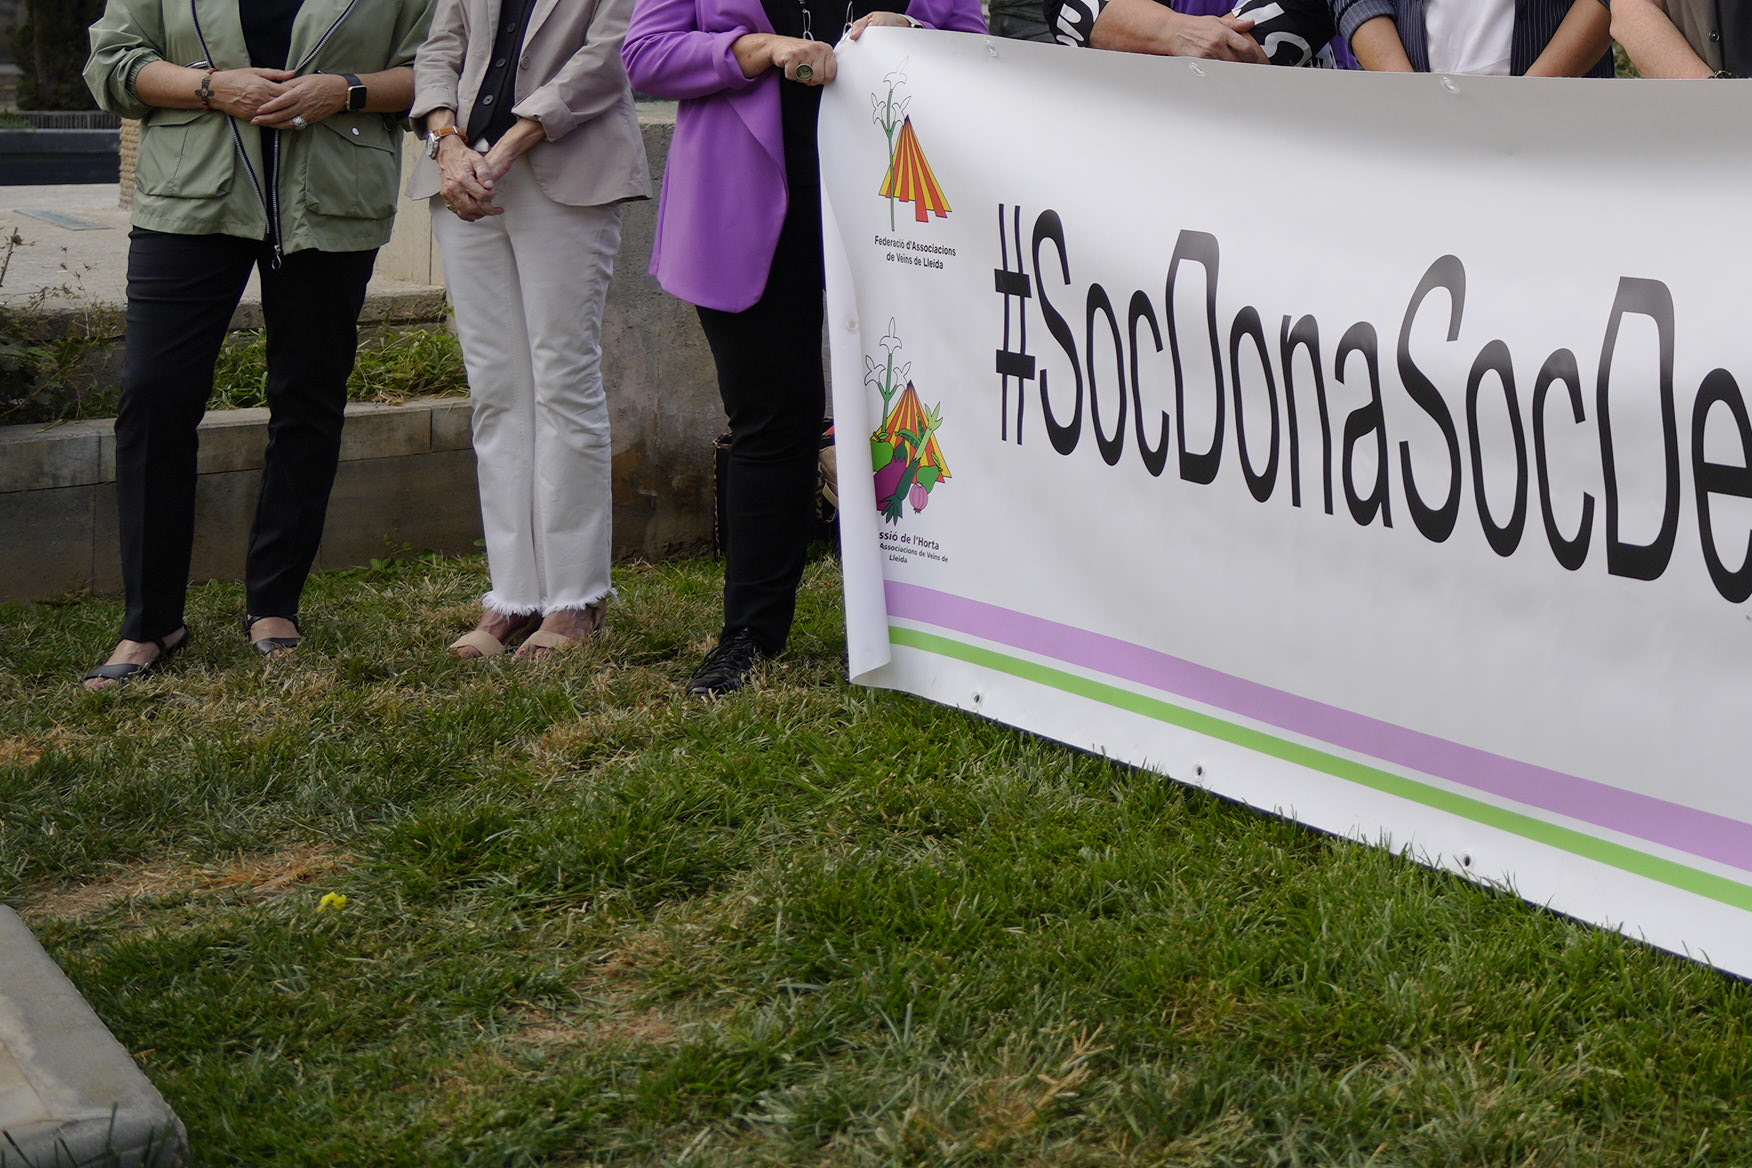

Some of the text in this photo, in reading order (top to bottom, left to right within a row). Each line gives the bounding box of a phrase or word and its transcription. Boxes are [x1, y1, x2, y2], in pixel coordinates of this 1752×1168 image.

[874, 235, 957, 257] Federació d'Associacions
[886, 251, 895, 262] de
[913, 256, 922, 266] de
[923, 257, 944, 270] Lleida
[879, 530, 940, 550] ssió de l'Horta
[889, 554, 908, 563] Lleida
[919, 550, 926, 558] de
[941, 555, 949, 563] de
